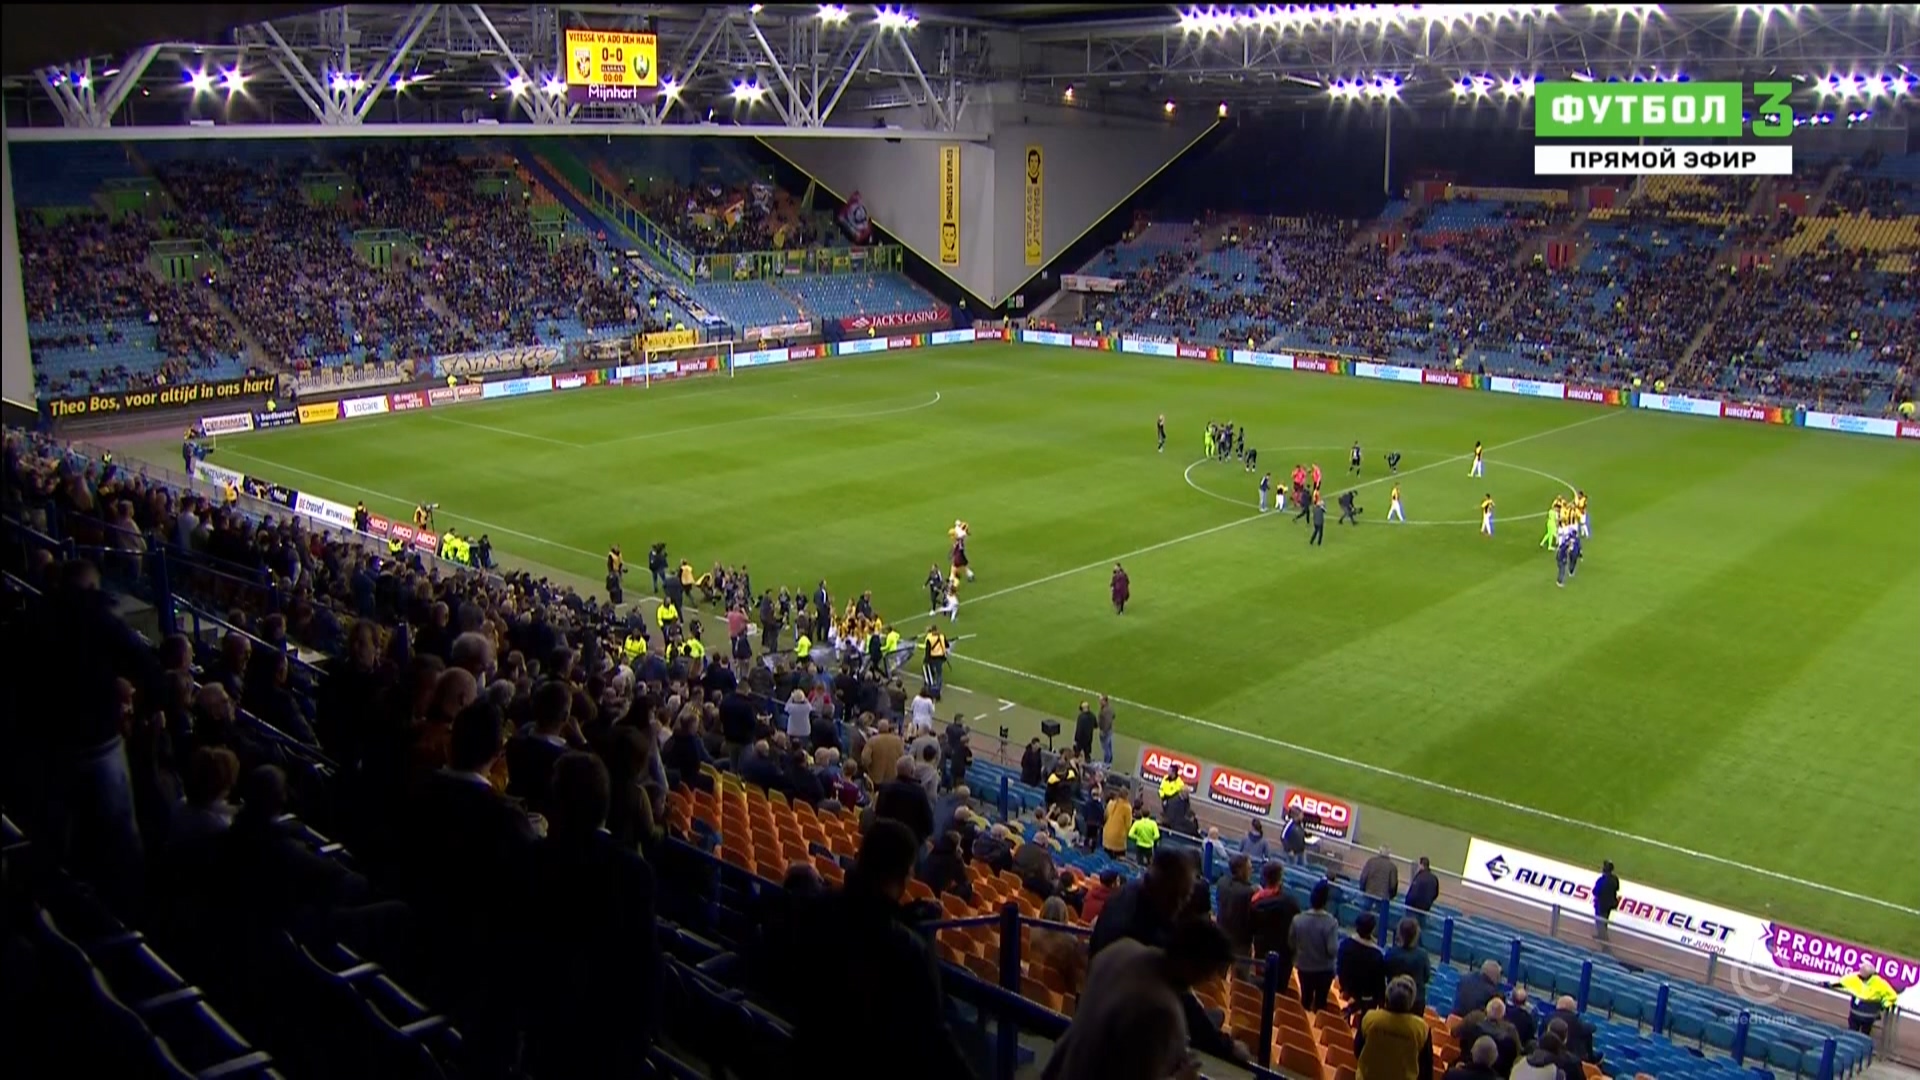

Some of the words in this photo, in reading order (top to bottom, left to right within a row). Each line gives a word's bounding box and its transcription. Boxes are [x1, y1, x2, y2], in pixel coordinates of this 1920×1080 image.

[568, 32, 596, 42] VITESSE
[597, 34, 606, 43] VS
[607, 35, 621, 44] ADO
[622, 35, 635, 44] DEN
[636, 36, 655, 46] HAAG
[588, 83, 637, 102] Mijnhart
[904, 311, 938, 321] CASINO
[50, 400, 86, 416] Theo
[90, 397, 120, 411] Bos,
[125, 394, 157, 407] voor
[160, 386, 197, 404] altijd
[201, 384, 213, 398] in
[217, 384, 240, 396] ons
[243, 378, 275, 393] hart!
[369, 518, 388, 531] ABCO
[392, 525, 412, 539] ABCO
[416, 532, 437, 545] ABCO
[1214, 772, 1270, 800] ABCO
[1211, 793, 1266, 814] BEVEILIGING
[1288, 793, 1347, 822] ABCO
[1514, 867, 1736, 942] AUTOSARTELST
[1680, 935, 1693, 944] BY
[1693, 940, 1727, 955] JUNIOR
[1774, 946, 1791, 960] XL
[1793, 951, 1854, 976] PRINTING
[1776, 928, 1918, 984] PROMOSIGN
